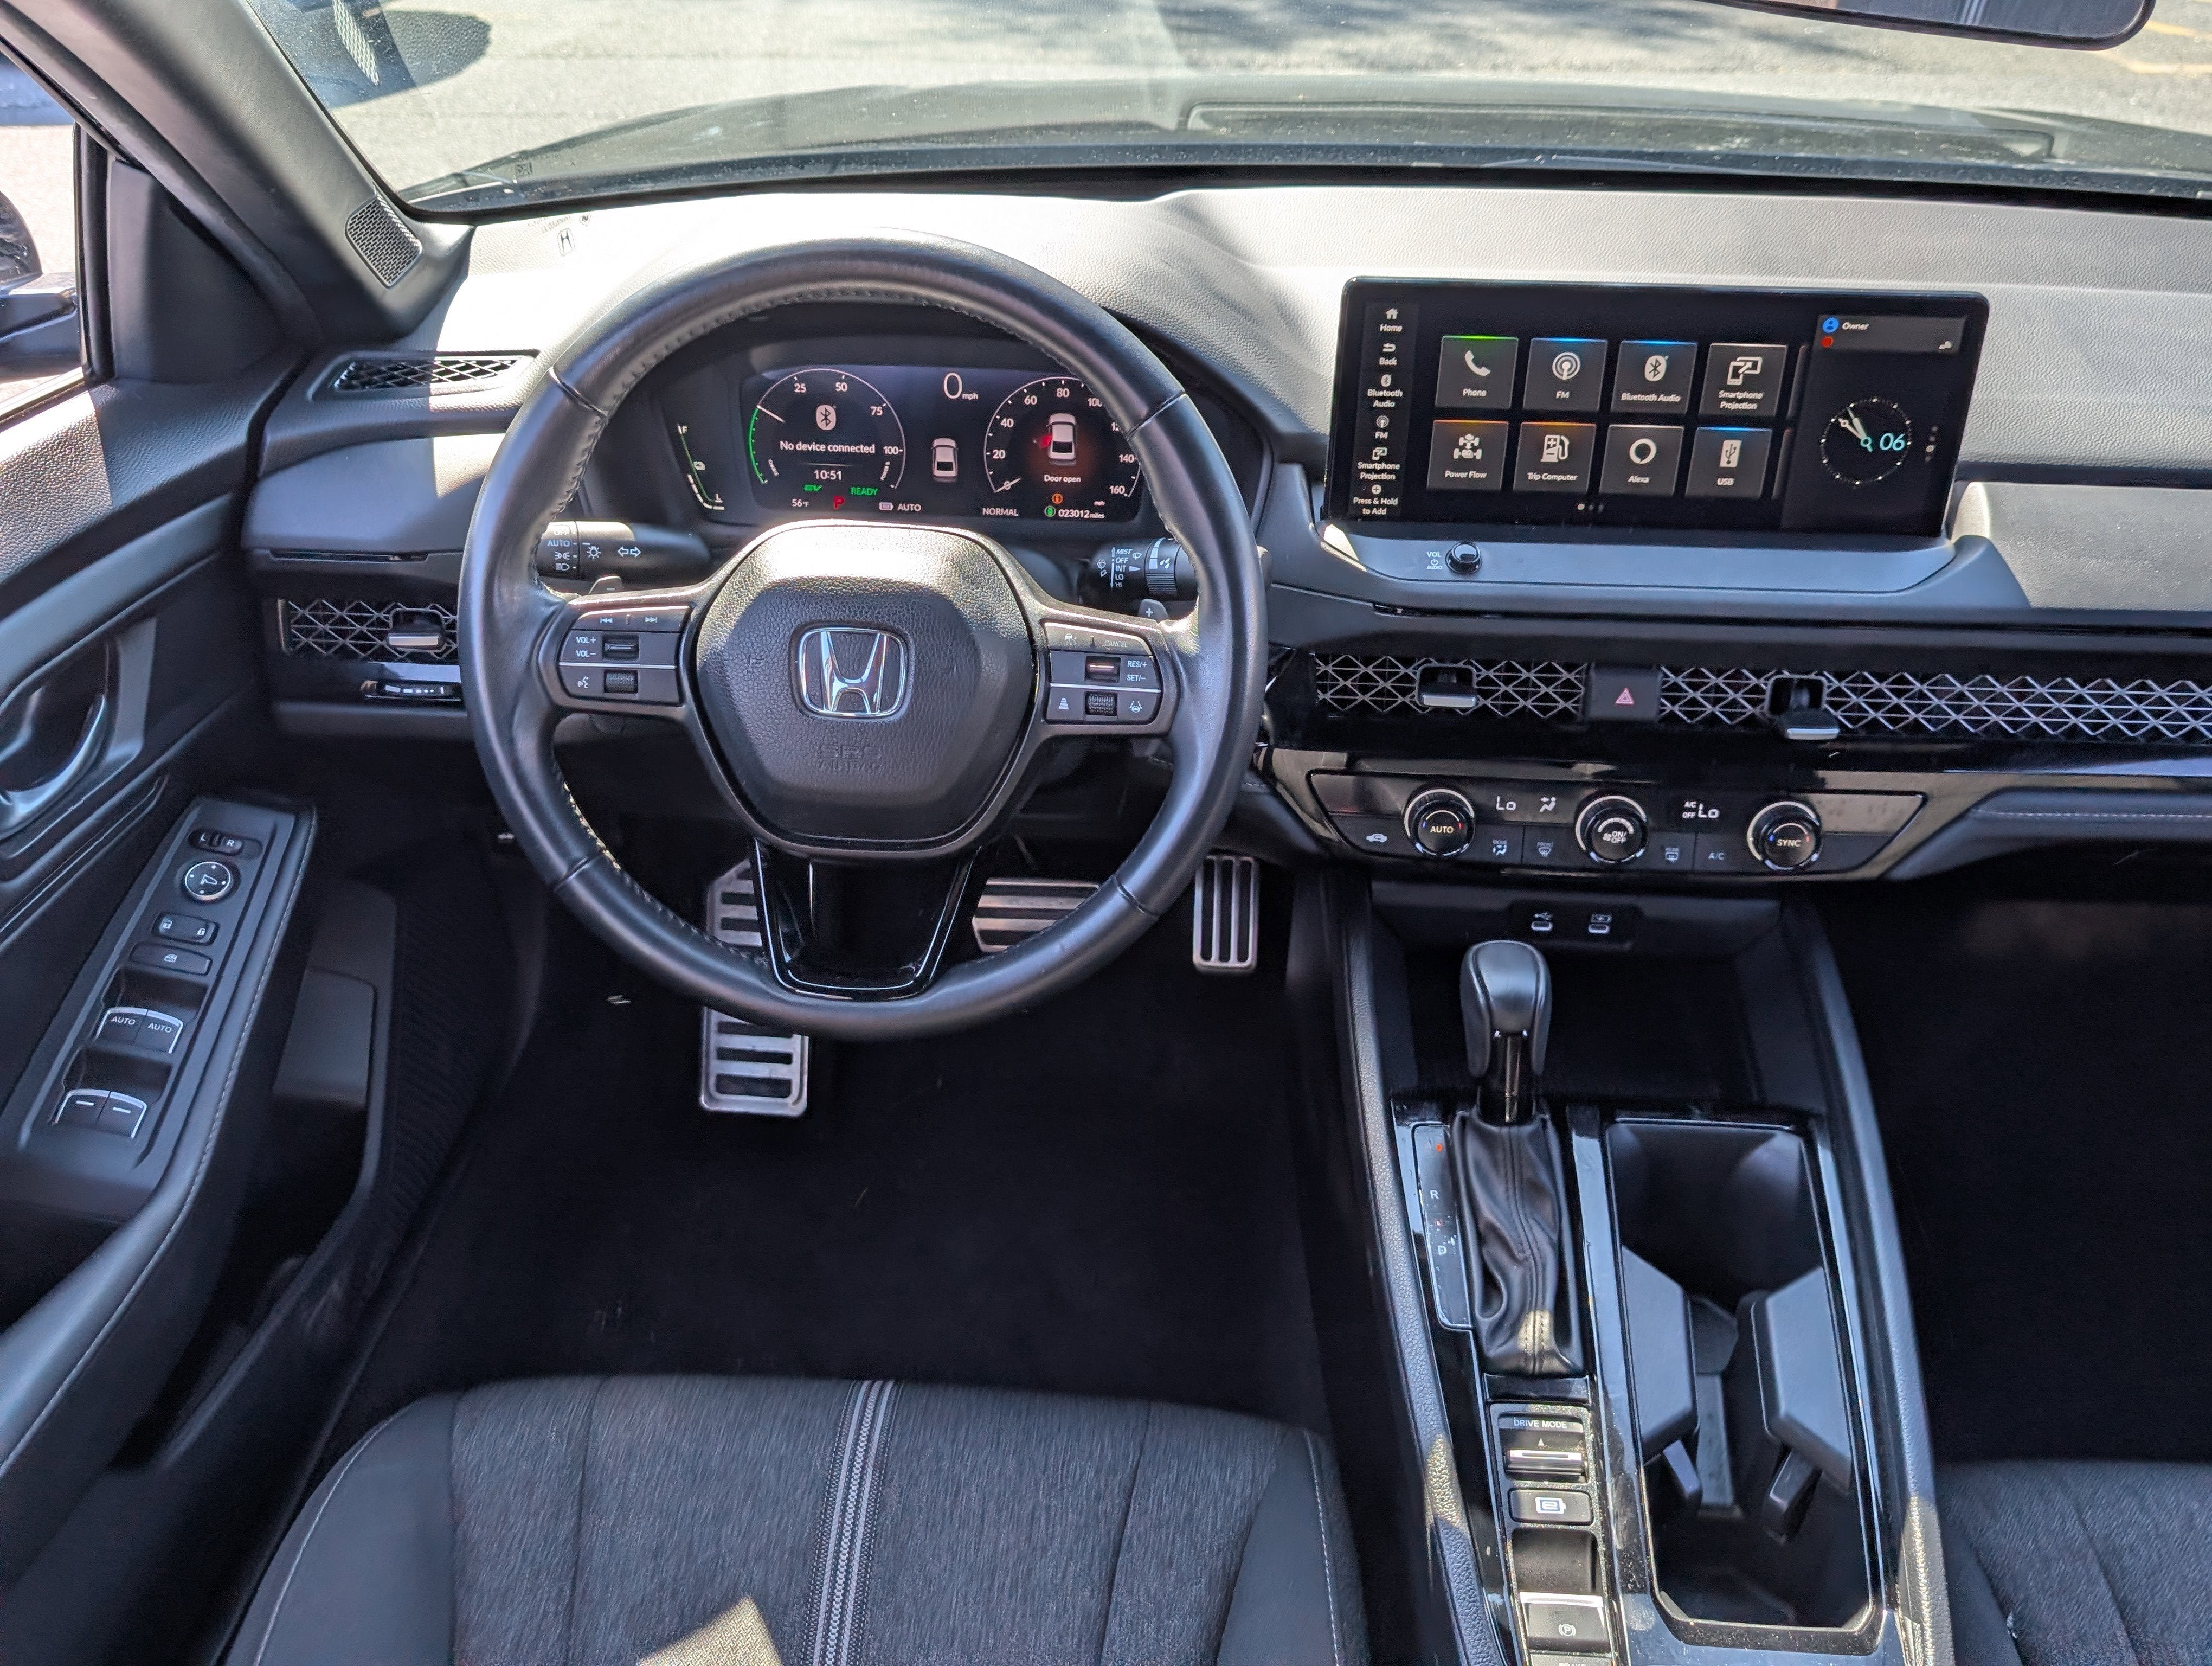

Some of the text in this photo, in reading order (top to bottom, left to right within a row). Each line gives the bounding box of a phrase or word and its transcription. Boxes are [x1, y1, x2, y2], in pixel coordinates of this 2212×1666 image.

[1379, 324, 1403, 332] Home
[1842, 322, 1869, 331] Owner
[1379, 357, 1397, 366] Back
[794, 383, 807, 393] 25
[835, 382, 848, 392] 50
[943, 372, 979, 400] 0 mph
[1056, 388, 1070, 398] 80
[1367, 388, 1403, 398] Bluetooth
[1462, 388, 1487, 397] Phone
[1555, 390, 1570, 399] FM
[1621, 392, 1681, 402] Bluetooth Audio
[1718, 390, 1763, 399] Smartphone
[1024, 395, 1037, 406] 60
[1373, 400, 1396, 408] Audio
[1720, 401, 1758, 410] Projection
[870, 406, 883, 415] 75
[1000, 418, 1014, 428] 40
[1879, 433, 1905, 451] 06
[780, 441, 875, 454] No device connected
[883, 446, 898, 455] 100
[992, 450, 1006, 459] 20
[1118, 454, 1134, 463] 140
[1358, 462, 1400, 471] Smartphone
[814, 469, 841, 480] 10:51
[1044, 474, 1062, 482] Door
[1360, 472, 1396, 480] Projection
[1527, 472, 1578, 481] Trip Computer
[1628, 475, 1650, 483] Alexa
[851, 486, 878, 496] READY
[1109, 485, 1125, 495] 160
[833, 496, 844, 509] P
[1380, 497, 1398, 505] Hold
[897, 503, 922, 511] AUTO
[982, 507, 1019, 516] NORMAL
[1371, 507, 1387, 515] Add
[111, 1016, 136, 1025] AUTO
[147, 1023, 172, 1033] AUTO
[1430, 1190, 1439, 1199] R
[1437, 1245, 1447, 1255] D
[1514, 1418, 1540, 1427] DRIVE
